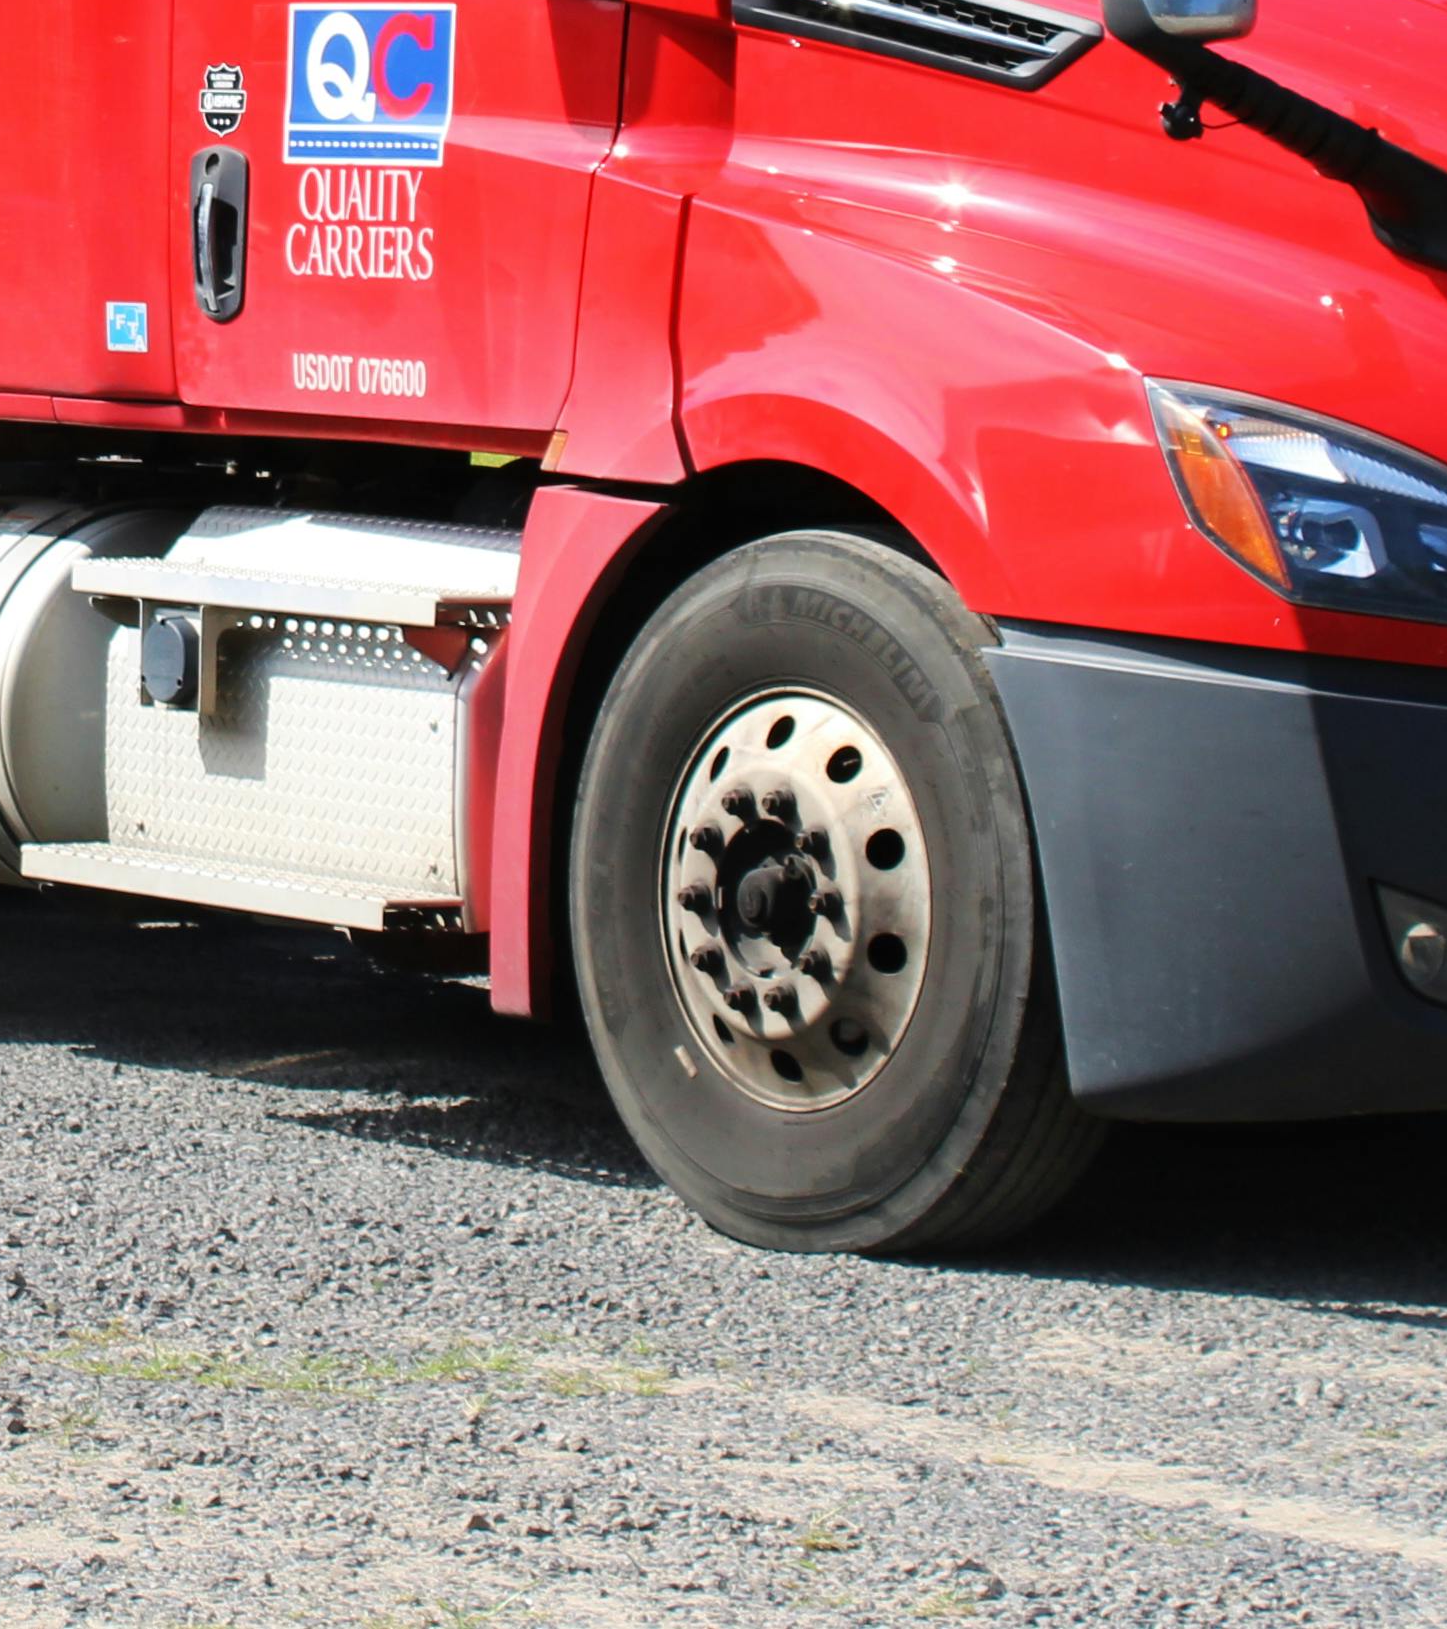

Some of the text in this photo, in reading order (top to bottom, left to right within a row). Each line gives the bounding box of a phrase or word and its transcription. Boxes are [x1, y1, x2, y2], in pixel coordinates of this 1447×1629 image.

[306, 11, 436, 122] QC
[298, 168, 424, 222] QUALITY
[285, 223, 435, 281] CARRIERS
[292, 353, 427, 399] USDOT 076600
[790, 587, 932, 708] MICHELIN
